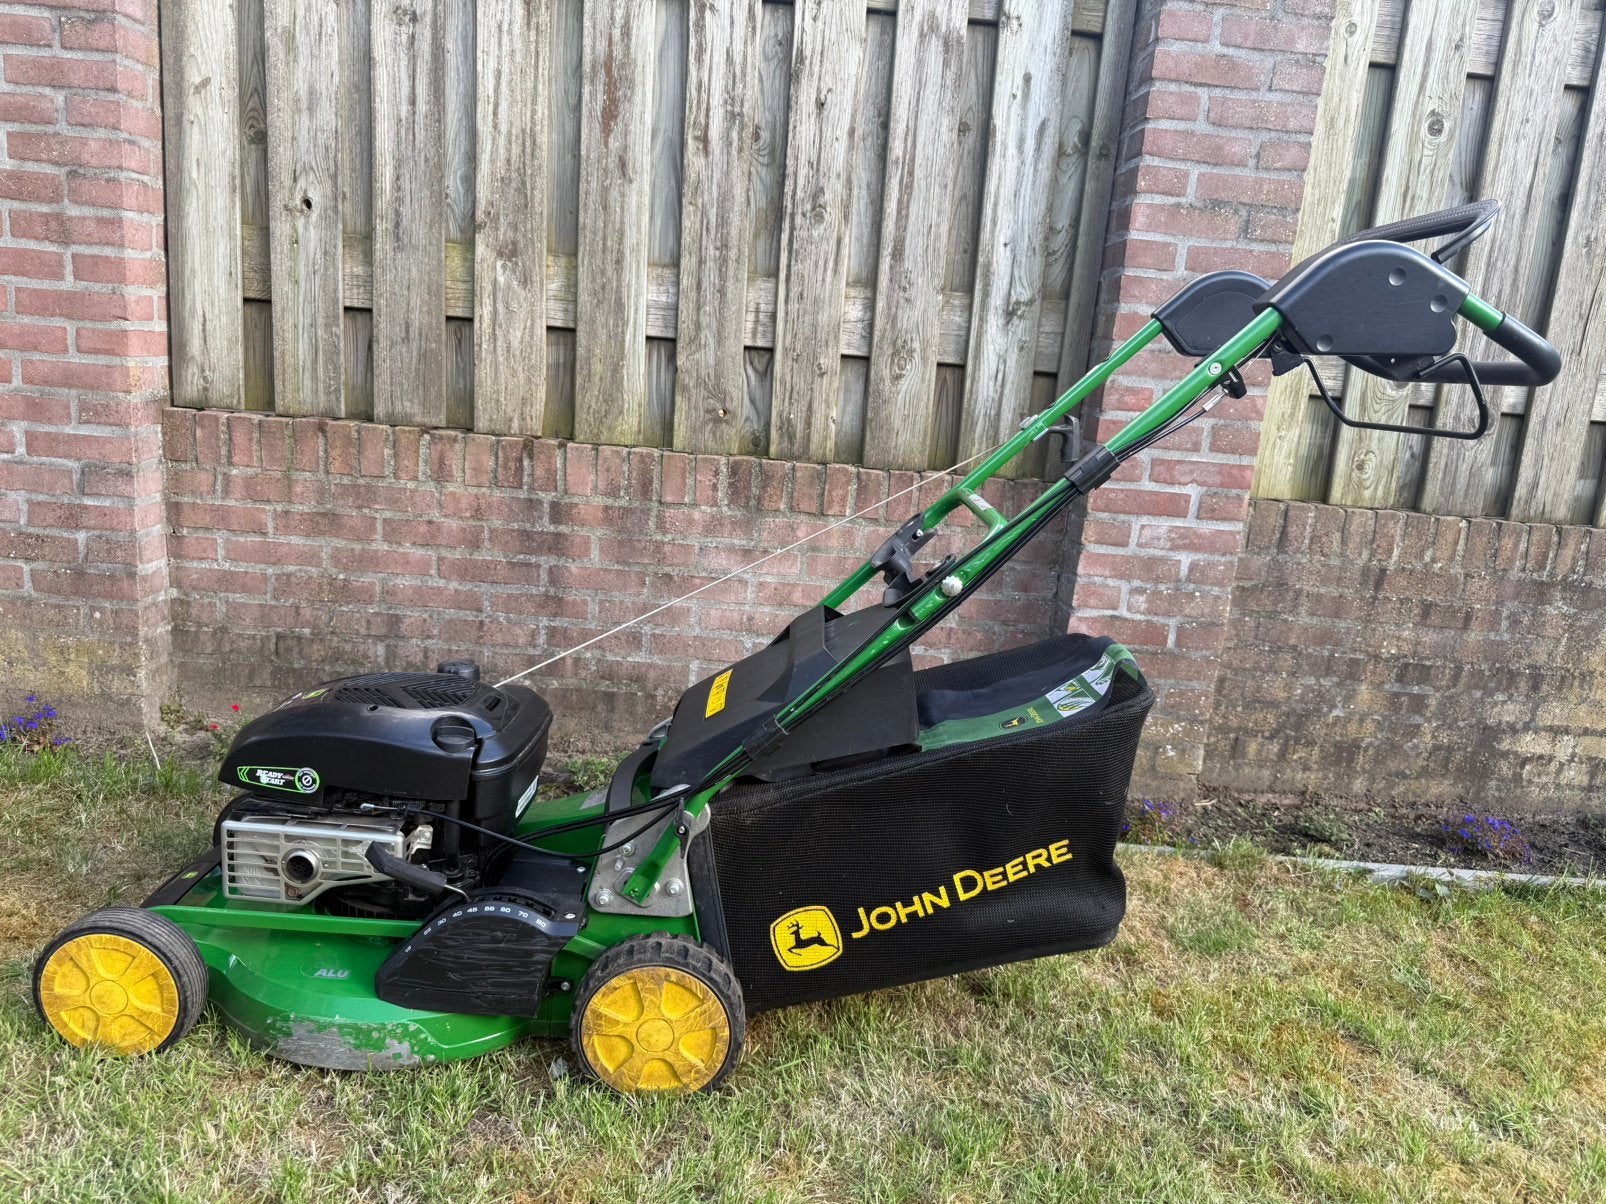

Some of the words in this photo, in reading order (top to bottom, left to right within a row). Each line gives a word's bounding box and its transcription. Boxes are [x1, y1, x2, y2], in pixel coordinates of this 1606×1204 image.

[256, 769, 283, 779] READY
[851, 885, 951, 939] JOHN
[953, 839, 1073, 902] DEERE
[452, 910, 462, 918] 40
[518, 910, 528, 918] 70
[313, 968, 350, 978] ALU
